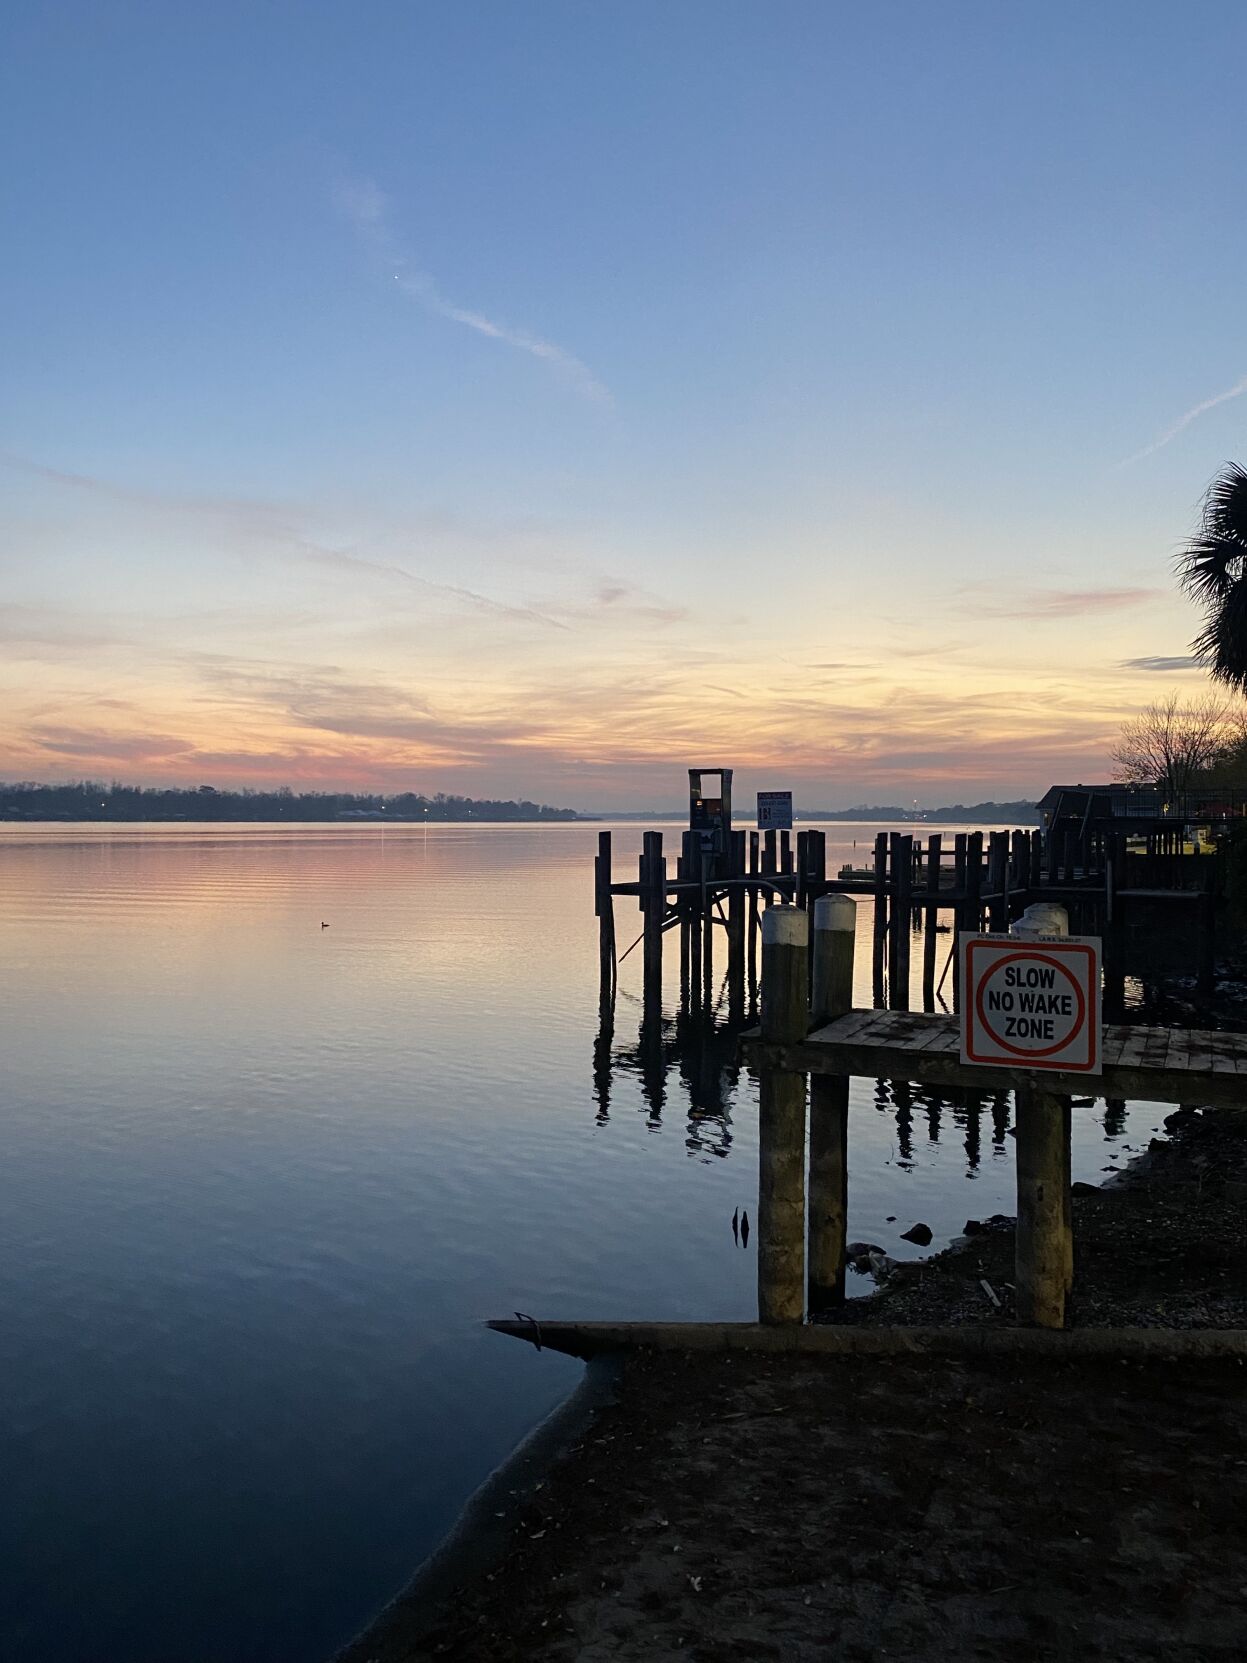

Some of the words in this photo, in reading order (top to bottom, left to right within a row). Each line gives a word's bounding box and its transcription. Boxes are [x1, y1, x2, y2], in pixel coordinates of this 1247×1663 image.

[1005, 966, 1055, 989] SLOW
[988, 990, 1014, 1012] NO
[1019, 992, 1072, 1016] WAKE
[1005, 1016, 1054, 1040] ZONE
